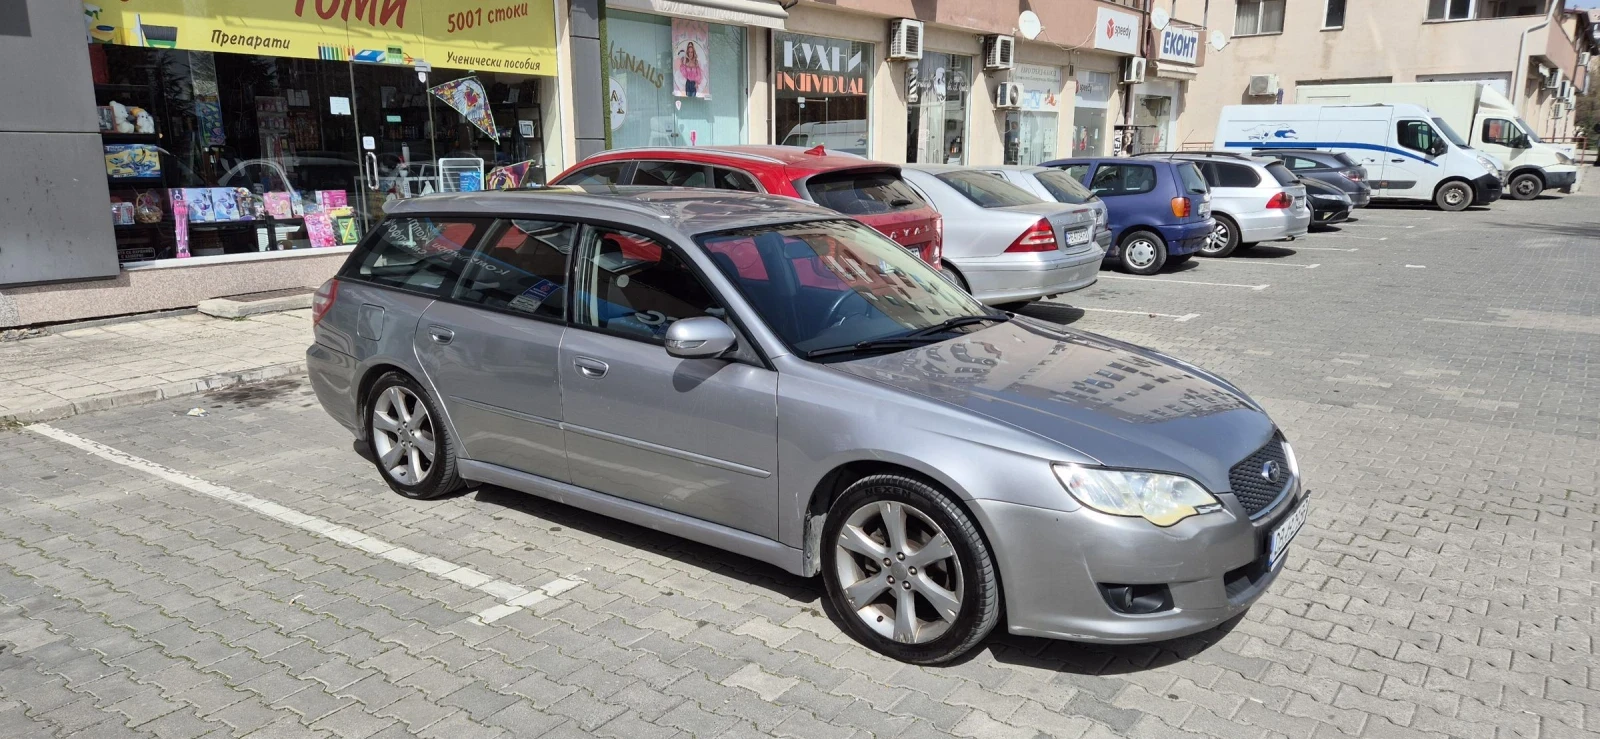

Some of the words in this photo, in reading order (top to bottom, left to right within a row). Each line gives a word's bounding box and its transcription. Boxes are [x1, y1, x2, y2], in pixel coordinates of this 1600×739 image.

[447, 7, 481, 33] 5001
[487, 3, 528, 24] стоки
[211, 29, 291, 50] Препарати
[1115, 25, 1131, 40] speedy
[1163, 31, 1196, 58] ЕКОНТ
[446, 51, 502, 68] Ученически
[504, 57, 541, 71] пособия
[783, 40, 862, 74] КУХНИ
[1080, 83, 1092, 94] speedy
[865, 486, 911, 498] NEXEN
